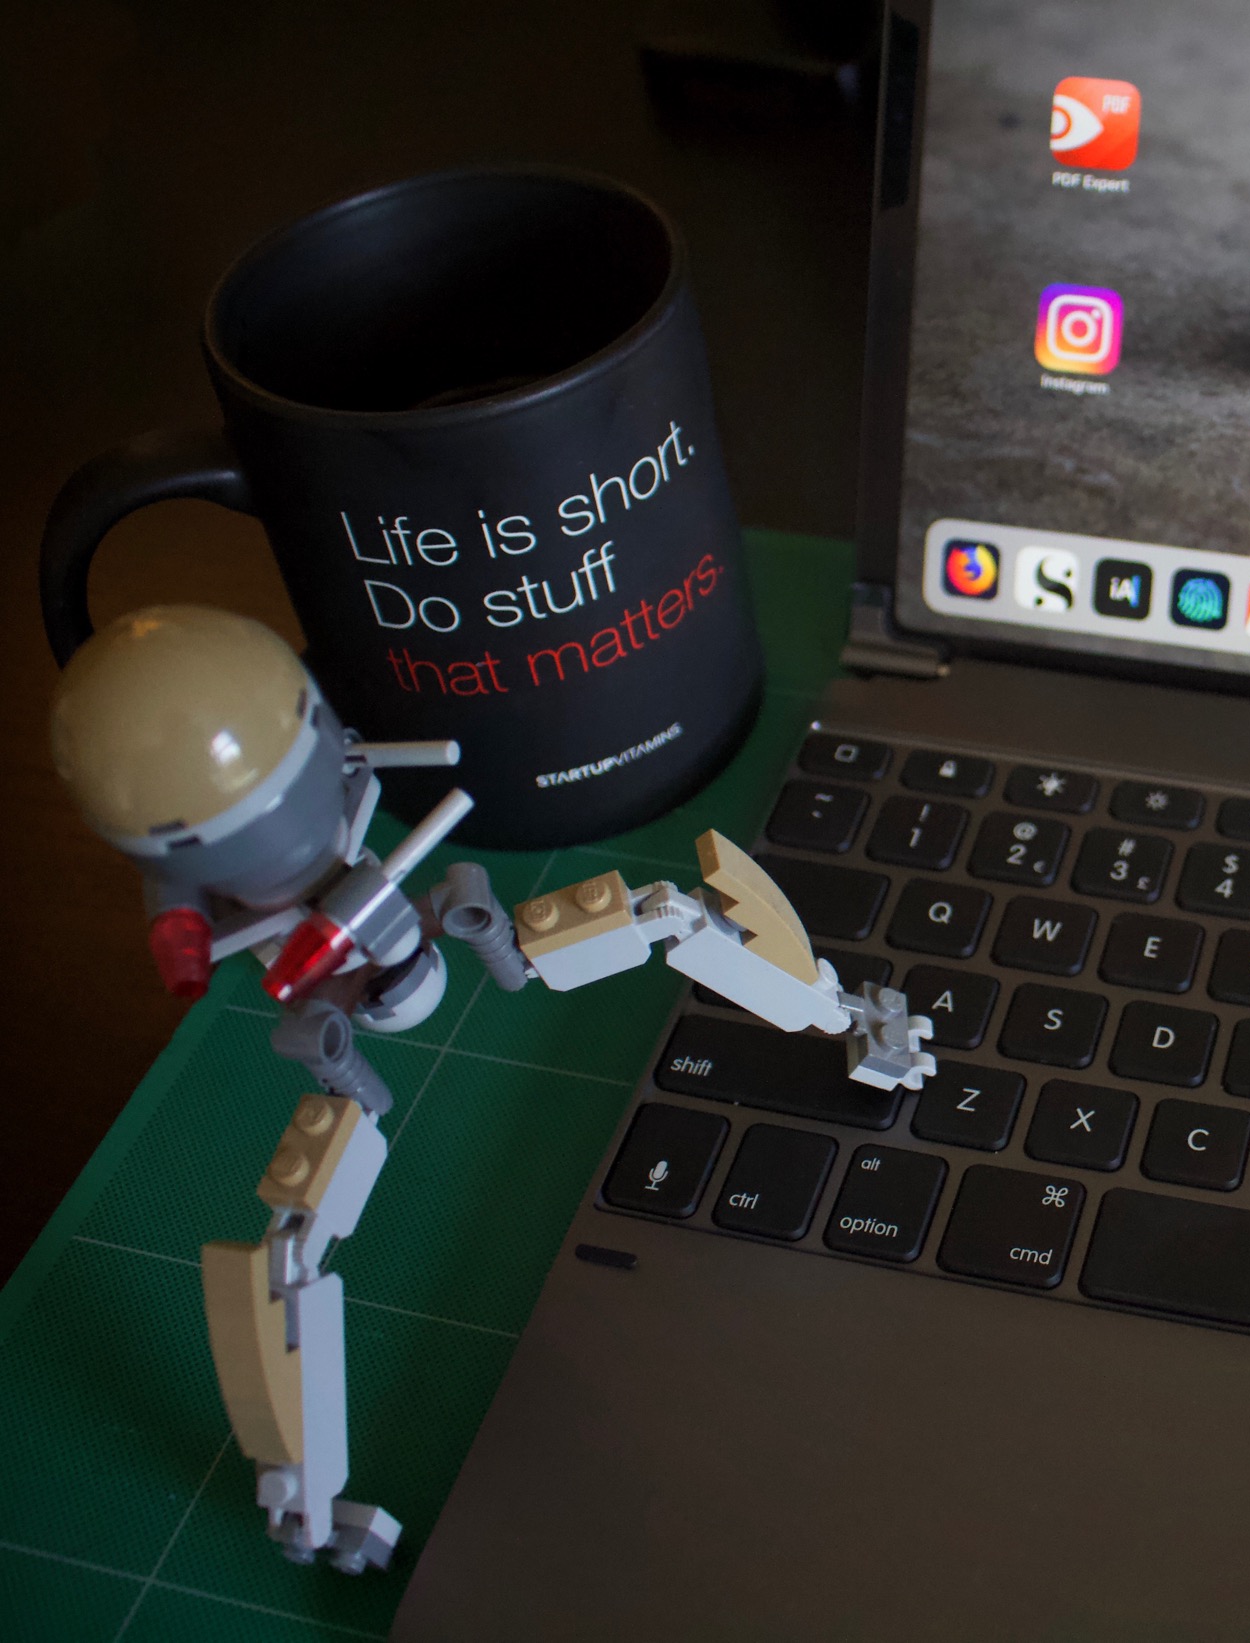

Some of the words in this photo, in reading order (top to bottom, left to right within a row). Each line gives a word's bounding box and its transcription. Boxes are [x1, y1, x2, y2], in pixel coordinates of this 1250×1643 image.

[1102, 94, 1131, 114] PDF
[1052, 171, 1081, 187] PDF
[1082, 174, 1130, 193] Expert
[1040, 373, 1111, 396] Instagram
[340, 511, 460, 567] Life
[477, 509, 537, 559] is
[557, 420, 697, 537] short.
[364, 578, 461, 633] Do
[483, 541, 617, 629] stuff
[387, 647, 509, 697] that
[526, 553, 726, 688] matters.
[909, 827, 922, 847] 1
[1012, 822, 1038, 841] @
[1006, 844, 1027, 865] 2
[1118, 839, 1136, 857] #
[1109, 860, 1129, 881] 3
[1222, 854, 1239, 874] $
[1215, 878, 1233, 898] 4
[928, 901, 953, 924] Q
[1032, 918, 1062, 942] W
[1143, 936, 1161, 959] E
[931, 990, 953, 1013] A
[1043, 1008, 1063, 1031] S
[1152, 1026, 1175, 1049] D
[671, 1056, 712, 1076] shift
[956, 1087, 981, 1112] Z
[1069, 1107, 1095, 1132] X
[1187, 1128, 1210, 1151] C
[862, 1157, 880, 1171] alt
[729, 1191, 759, 1209] ctrl
[840, 1215, 898, 1238] option
[1010, 1246, 1052, 1265] cmd
